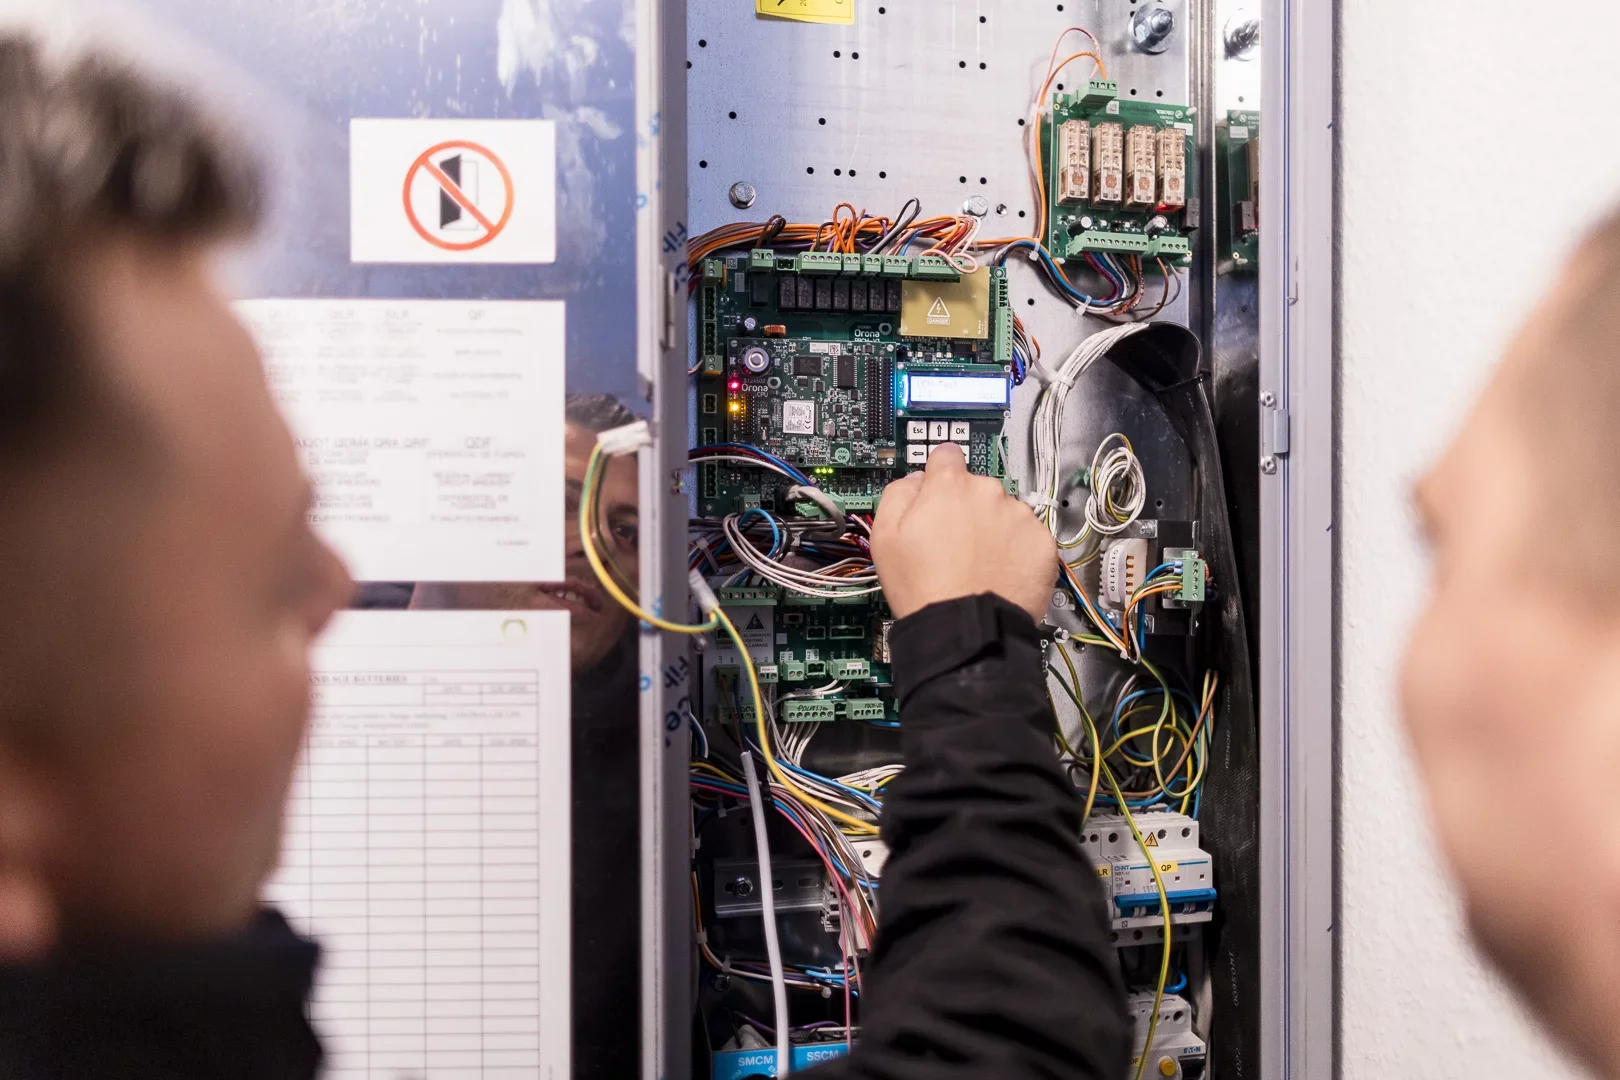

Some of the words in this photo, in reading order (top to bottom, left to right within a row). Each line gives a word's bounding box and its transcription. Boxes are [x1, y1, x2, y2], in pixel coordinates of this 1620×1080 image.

[854, 329, 880, 338] Orona
[1161, 864, 1172, 872] QP
[806, 1050, 839, 1061] SSCM
[738, 1055, 774, 1067] SMCM
